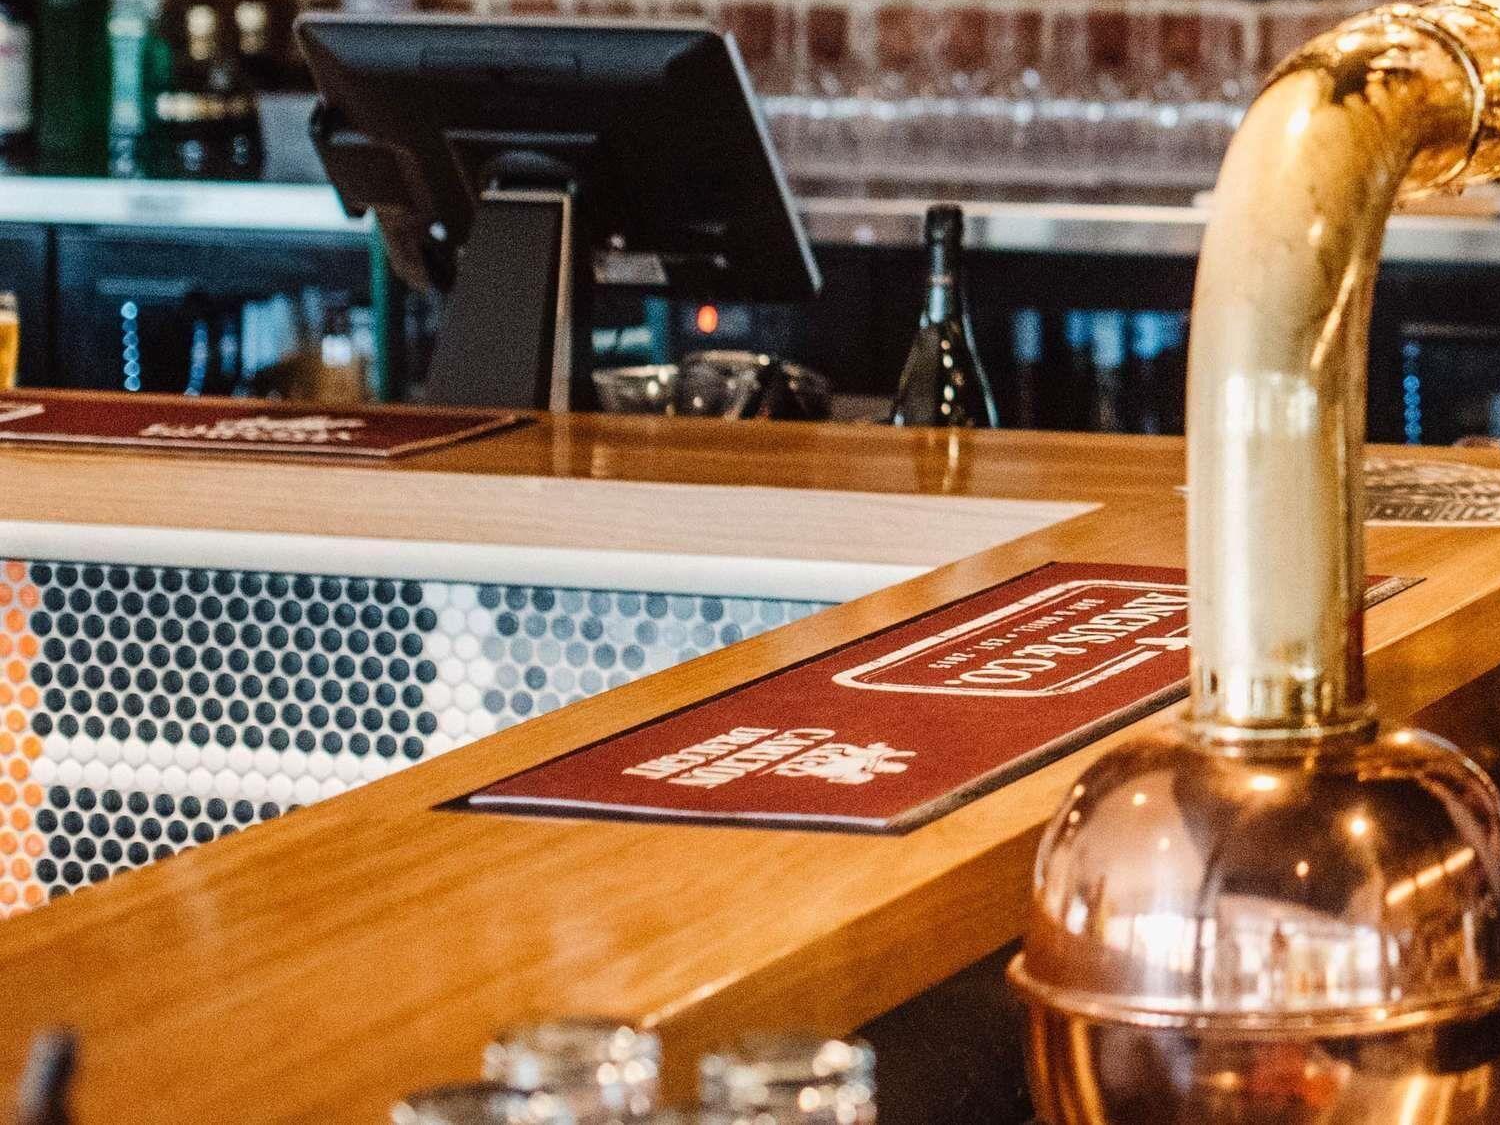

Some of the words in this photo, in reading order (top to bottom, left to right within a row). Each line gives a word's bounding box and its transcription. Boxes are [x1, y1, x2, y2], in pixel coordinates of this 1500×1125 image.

[1048, 592, 1191, 642] ANGUS
[1013, 644, 1088, 657] &
[944, 658, 1057, 684] CO.
